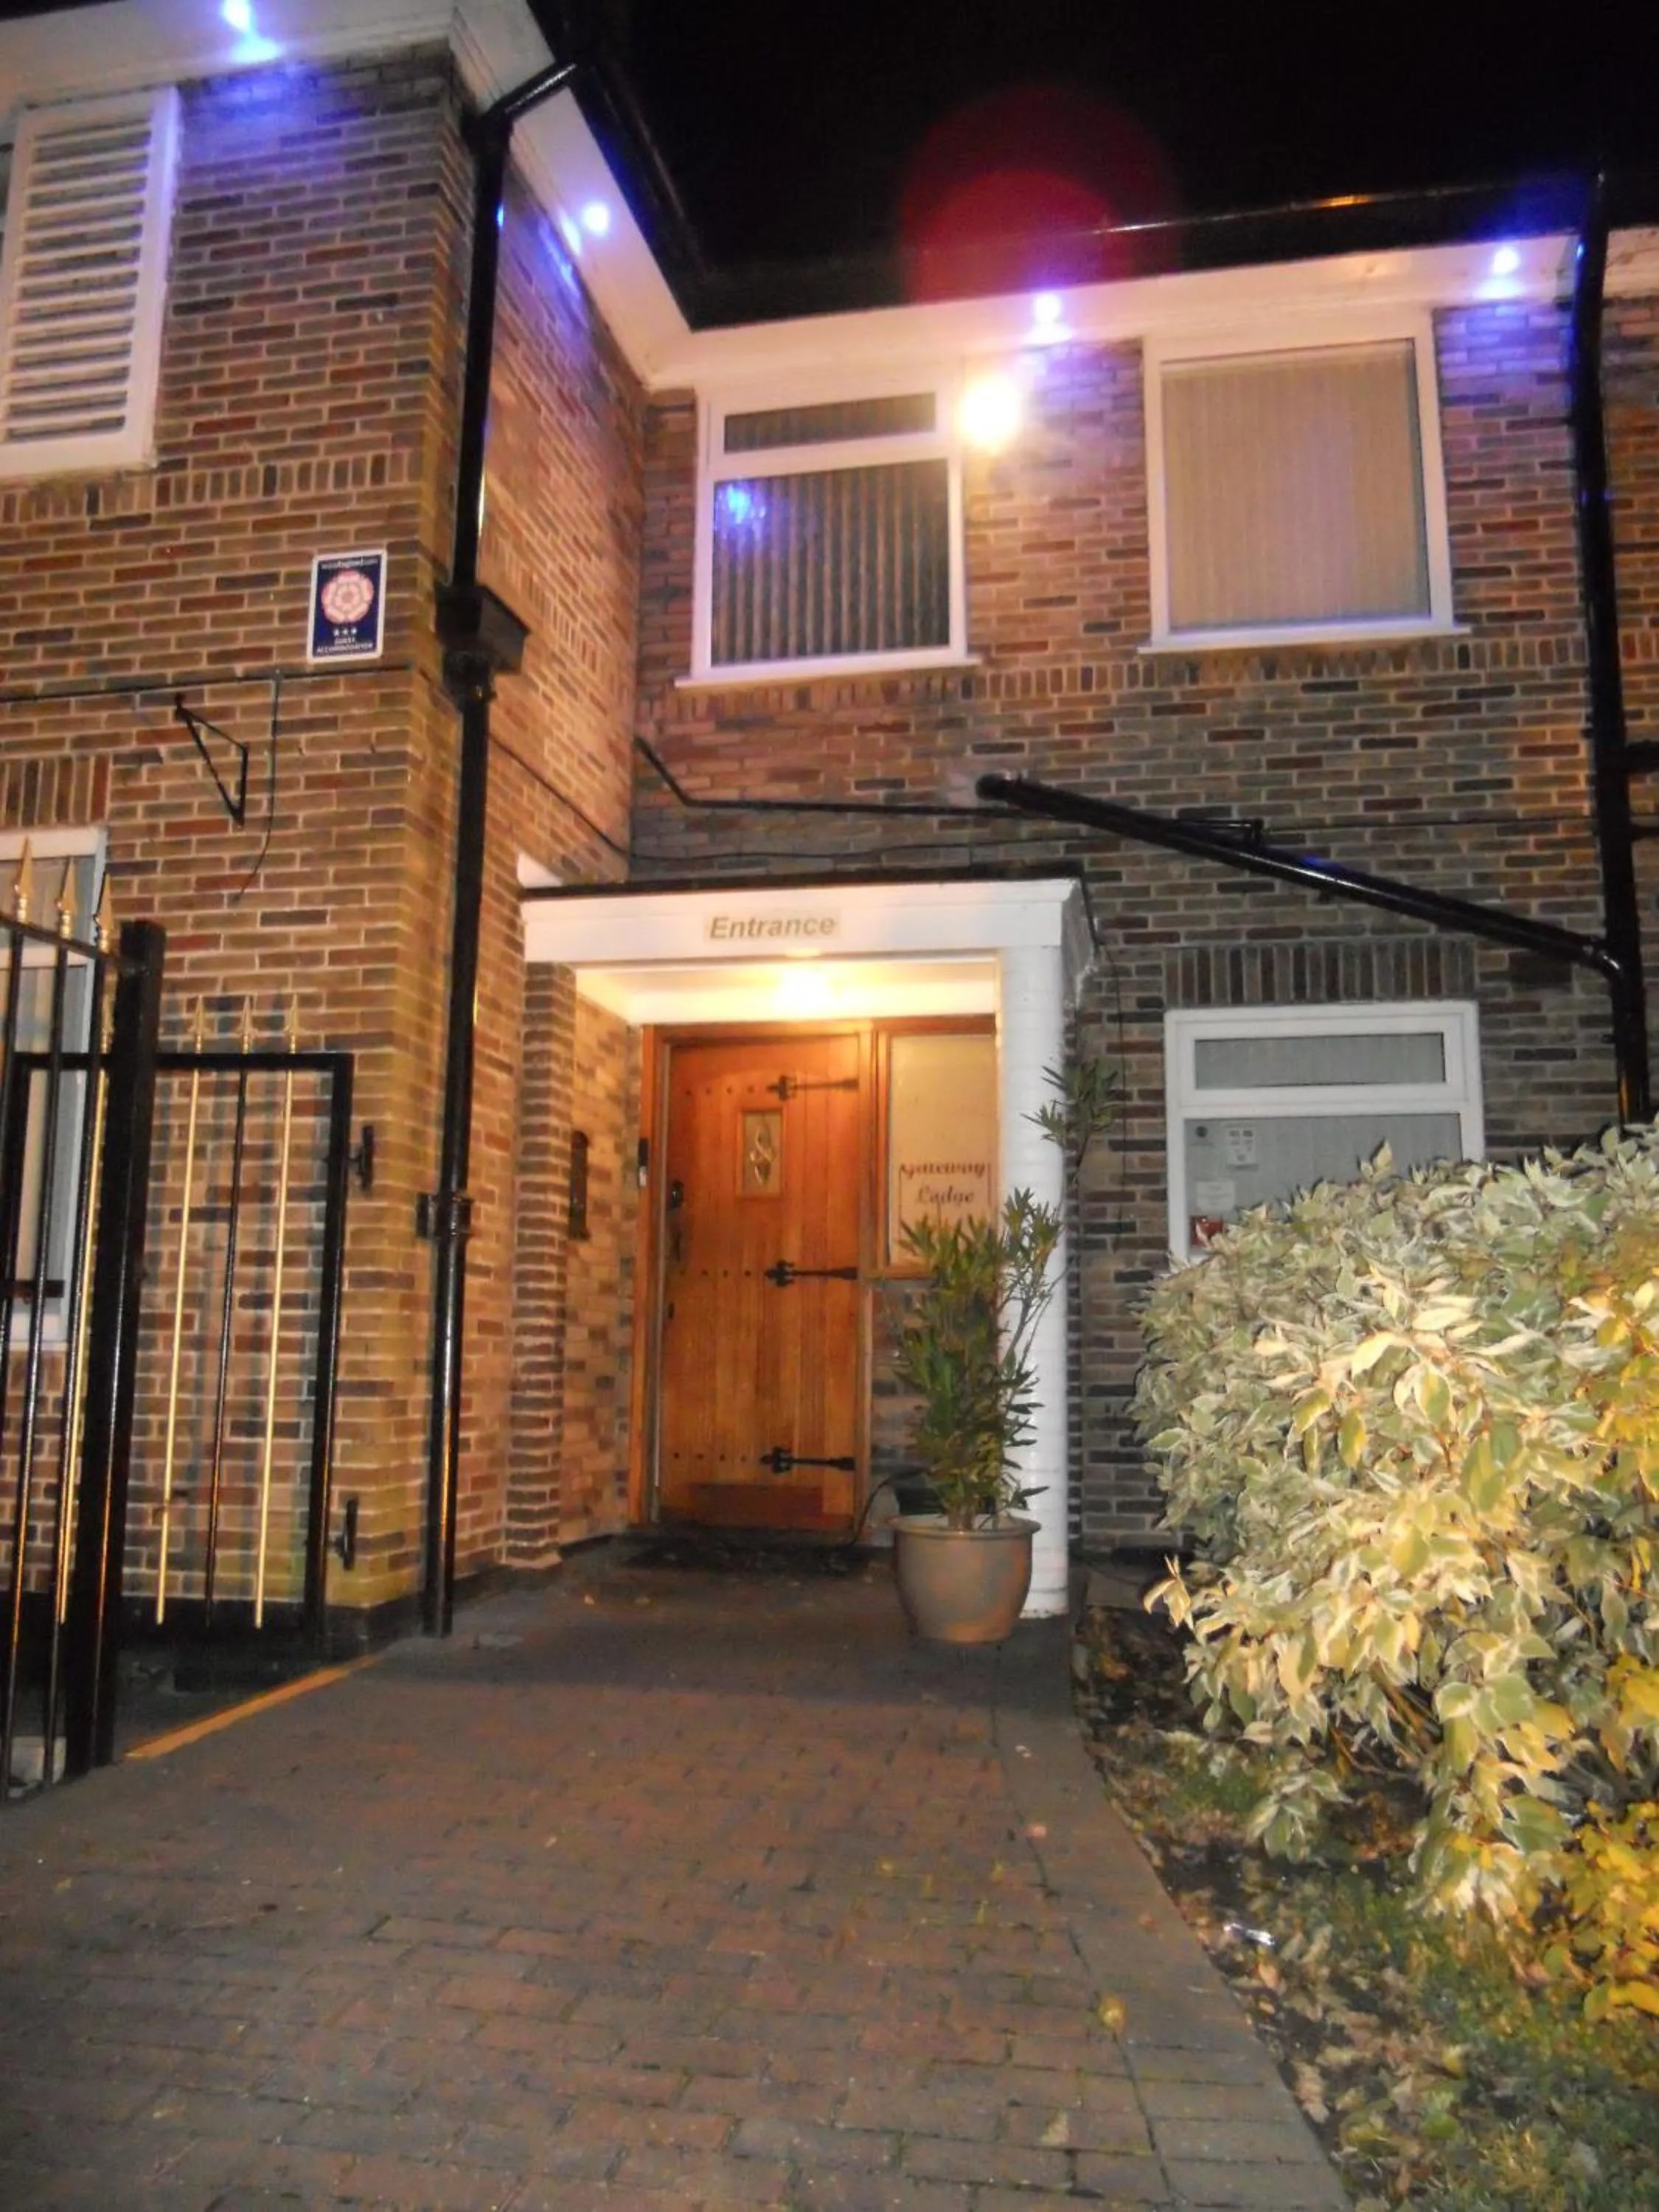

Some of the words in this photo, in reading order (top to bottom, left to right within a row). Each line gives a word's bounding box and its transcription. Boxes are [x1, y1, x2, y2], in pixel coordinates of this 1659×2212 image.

[709, 916, 835, 939] Entrance
[900, 1162, 986, 1180] Gateway
[916, 1185, 975, 1206] Lodge
